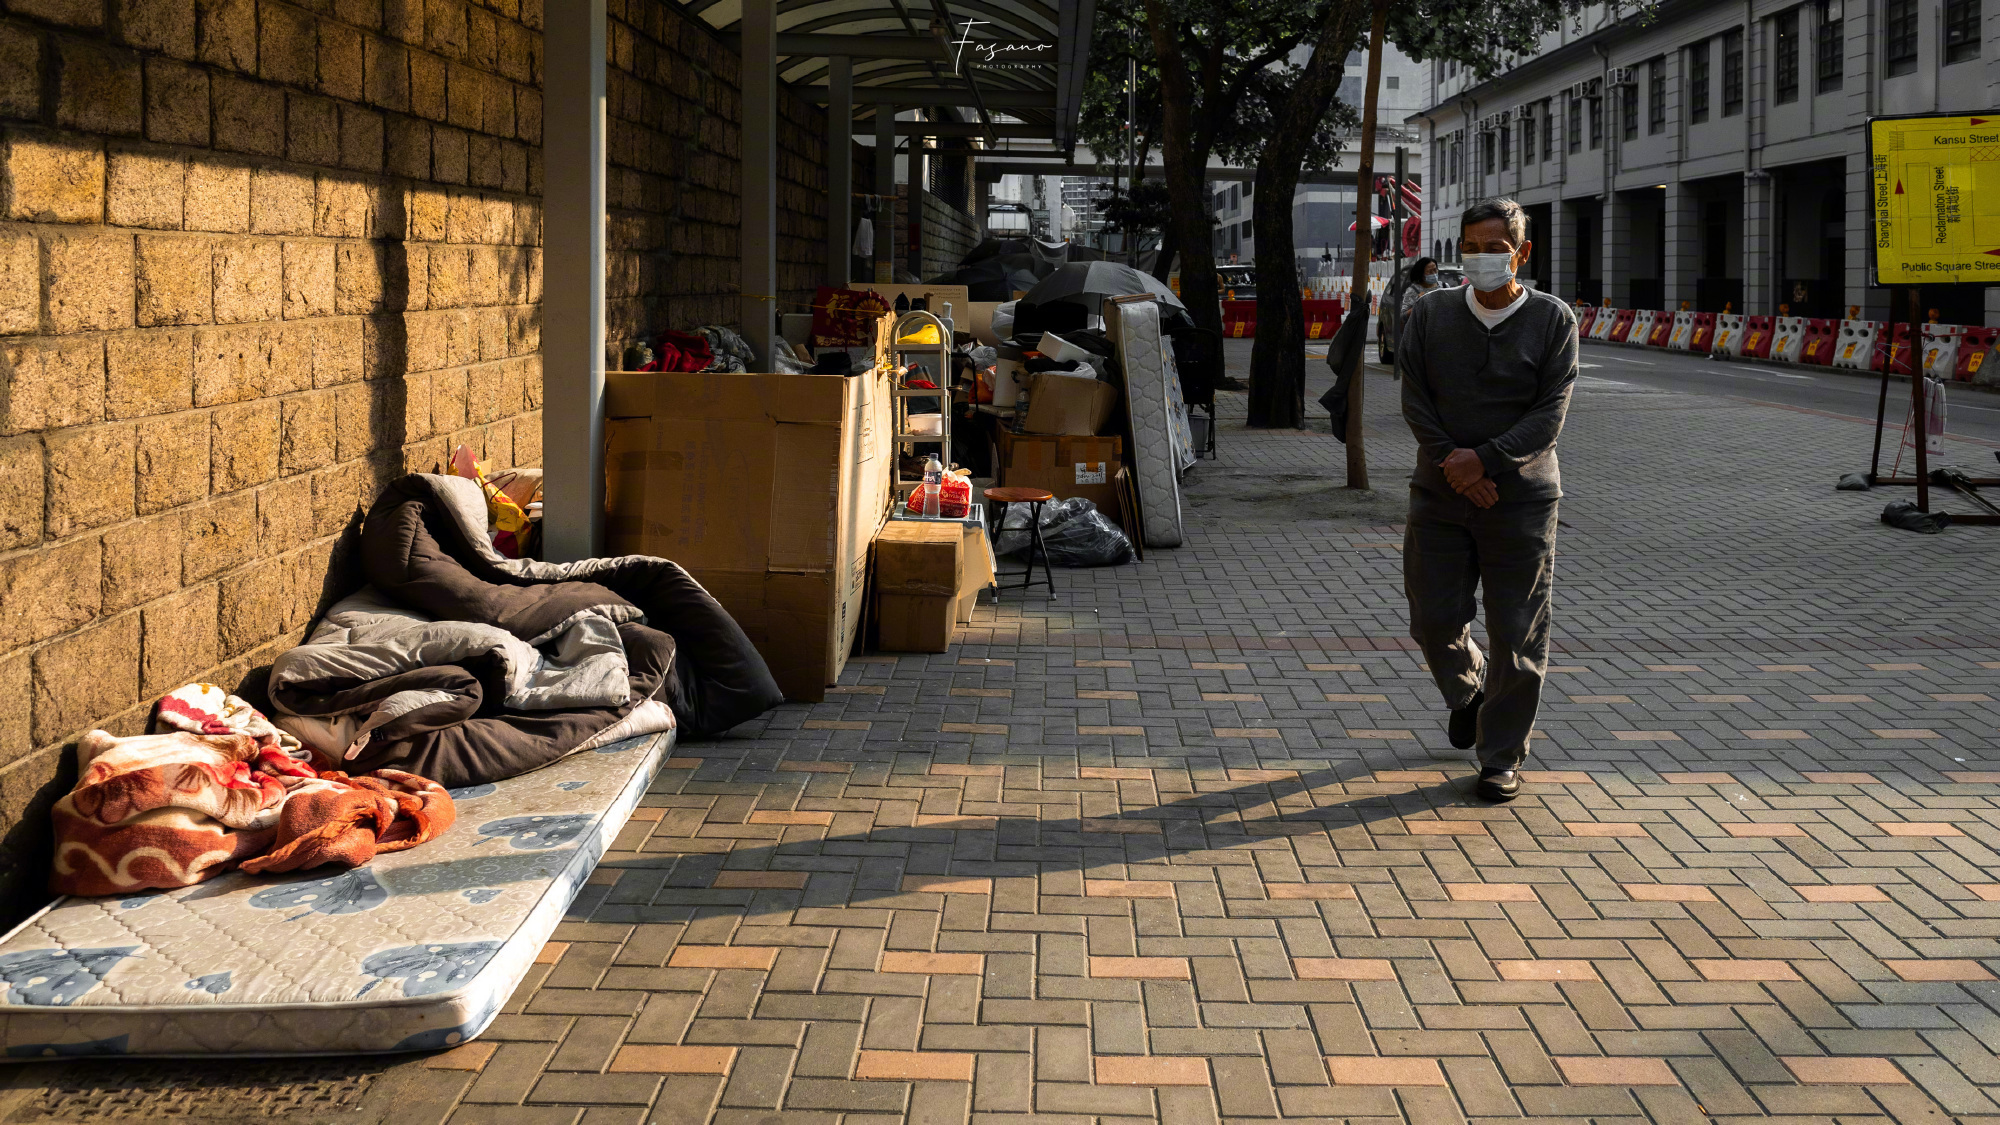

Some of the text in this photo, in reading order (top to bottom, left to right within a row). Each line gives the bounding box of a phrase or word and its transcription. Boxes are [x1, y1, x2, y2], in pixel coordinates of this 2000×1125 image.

[1934, 133, 2000, 145] Kansu Street
[1874, 154, 1891, 248] Shanghai Street 上海街
[1933, 166, 1947, 243] Reclamation Street
[1946, 186, 1961, 223] 新填地街
[1901, 261, 2000, 273] Public Square Stree
